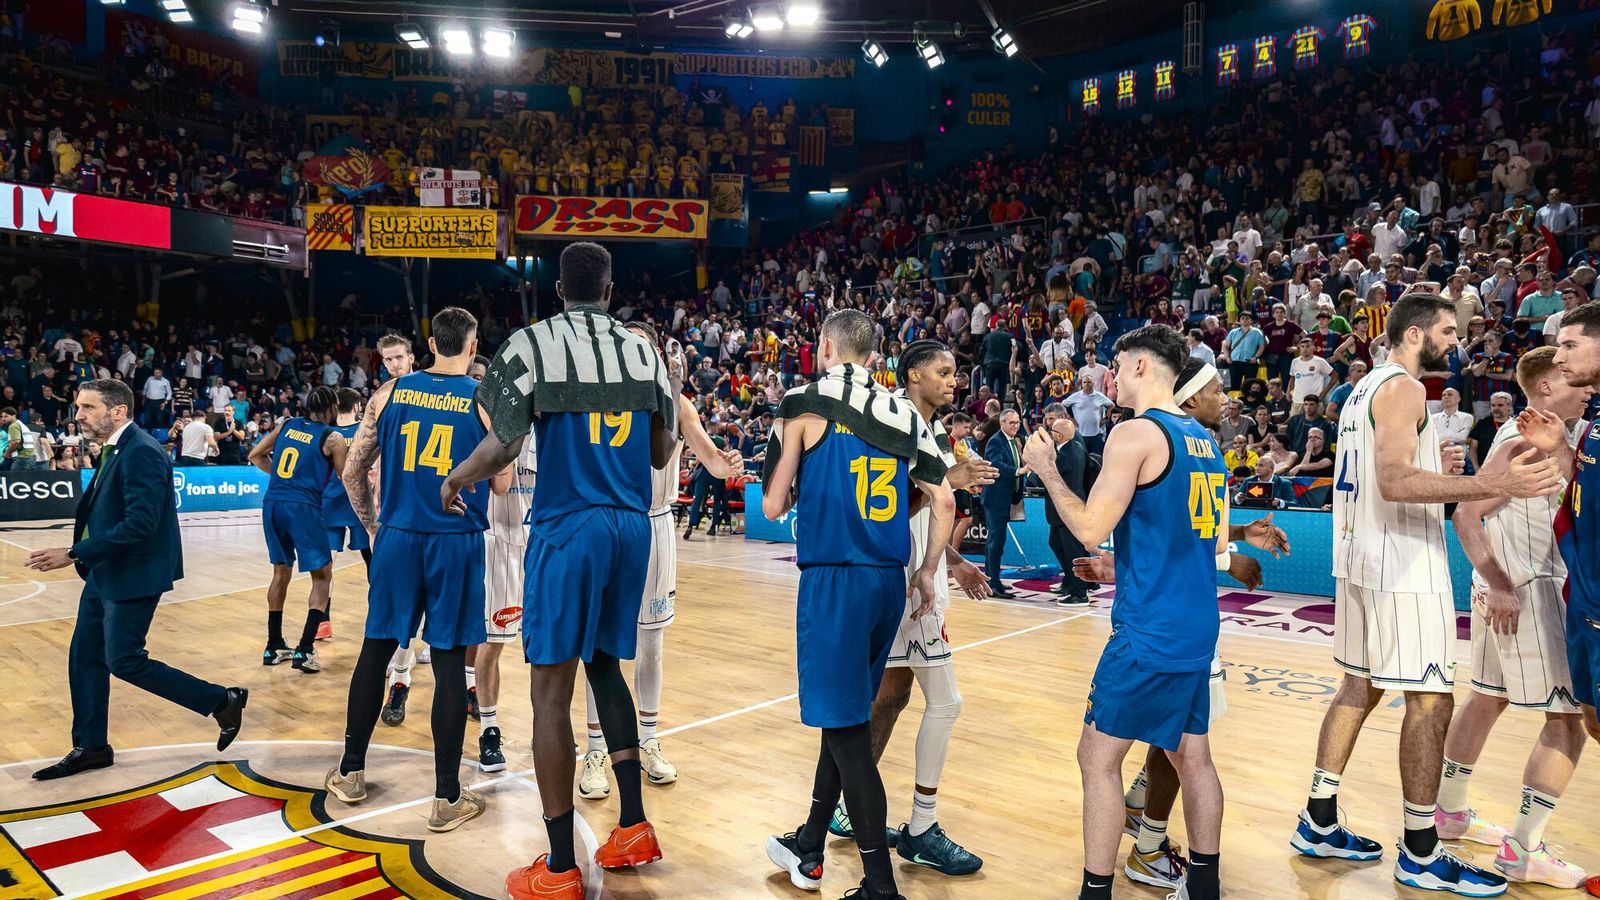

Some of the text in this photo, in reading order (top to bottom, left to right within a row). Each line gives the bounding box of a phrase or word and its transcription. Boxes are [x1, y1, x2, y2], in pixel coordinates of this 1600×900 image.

[1350, 26, 1362, 41] 9
[1296, 37, 1315, 53] 21
[1222, 55, 1232, 70] 7
[1258, 47, 1270, 61] 4
[674, 53, 777, 76] SUPPORTERS
[1117, 80, 1134, 96] 12
[970, 92, 1010, 108] 100%
[967, 110, 1012, 127] CULER
[517, 196, 705, 233] DRACS
[370, 215, 495, 233] SUPPORTERS
[552, 221, 664, 234] 1991
[393, 388, 473, 413] HERNANGÓMEZ
[284, 428, 314, 445] PUNTER
[400, 420, 455, 476] 14
[1184, 435, 1216, 459] VILLAR
[276, 446, 300, 479] 0
[186, 480, 260, 497] fora de joc
[850, 455, 898, 522] 13
[1188, 471, 1225, 539] 45
